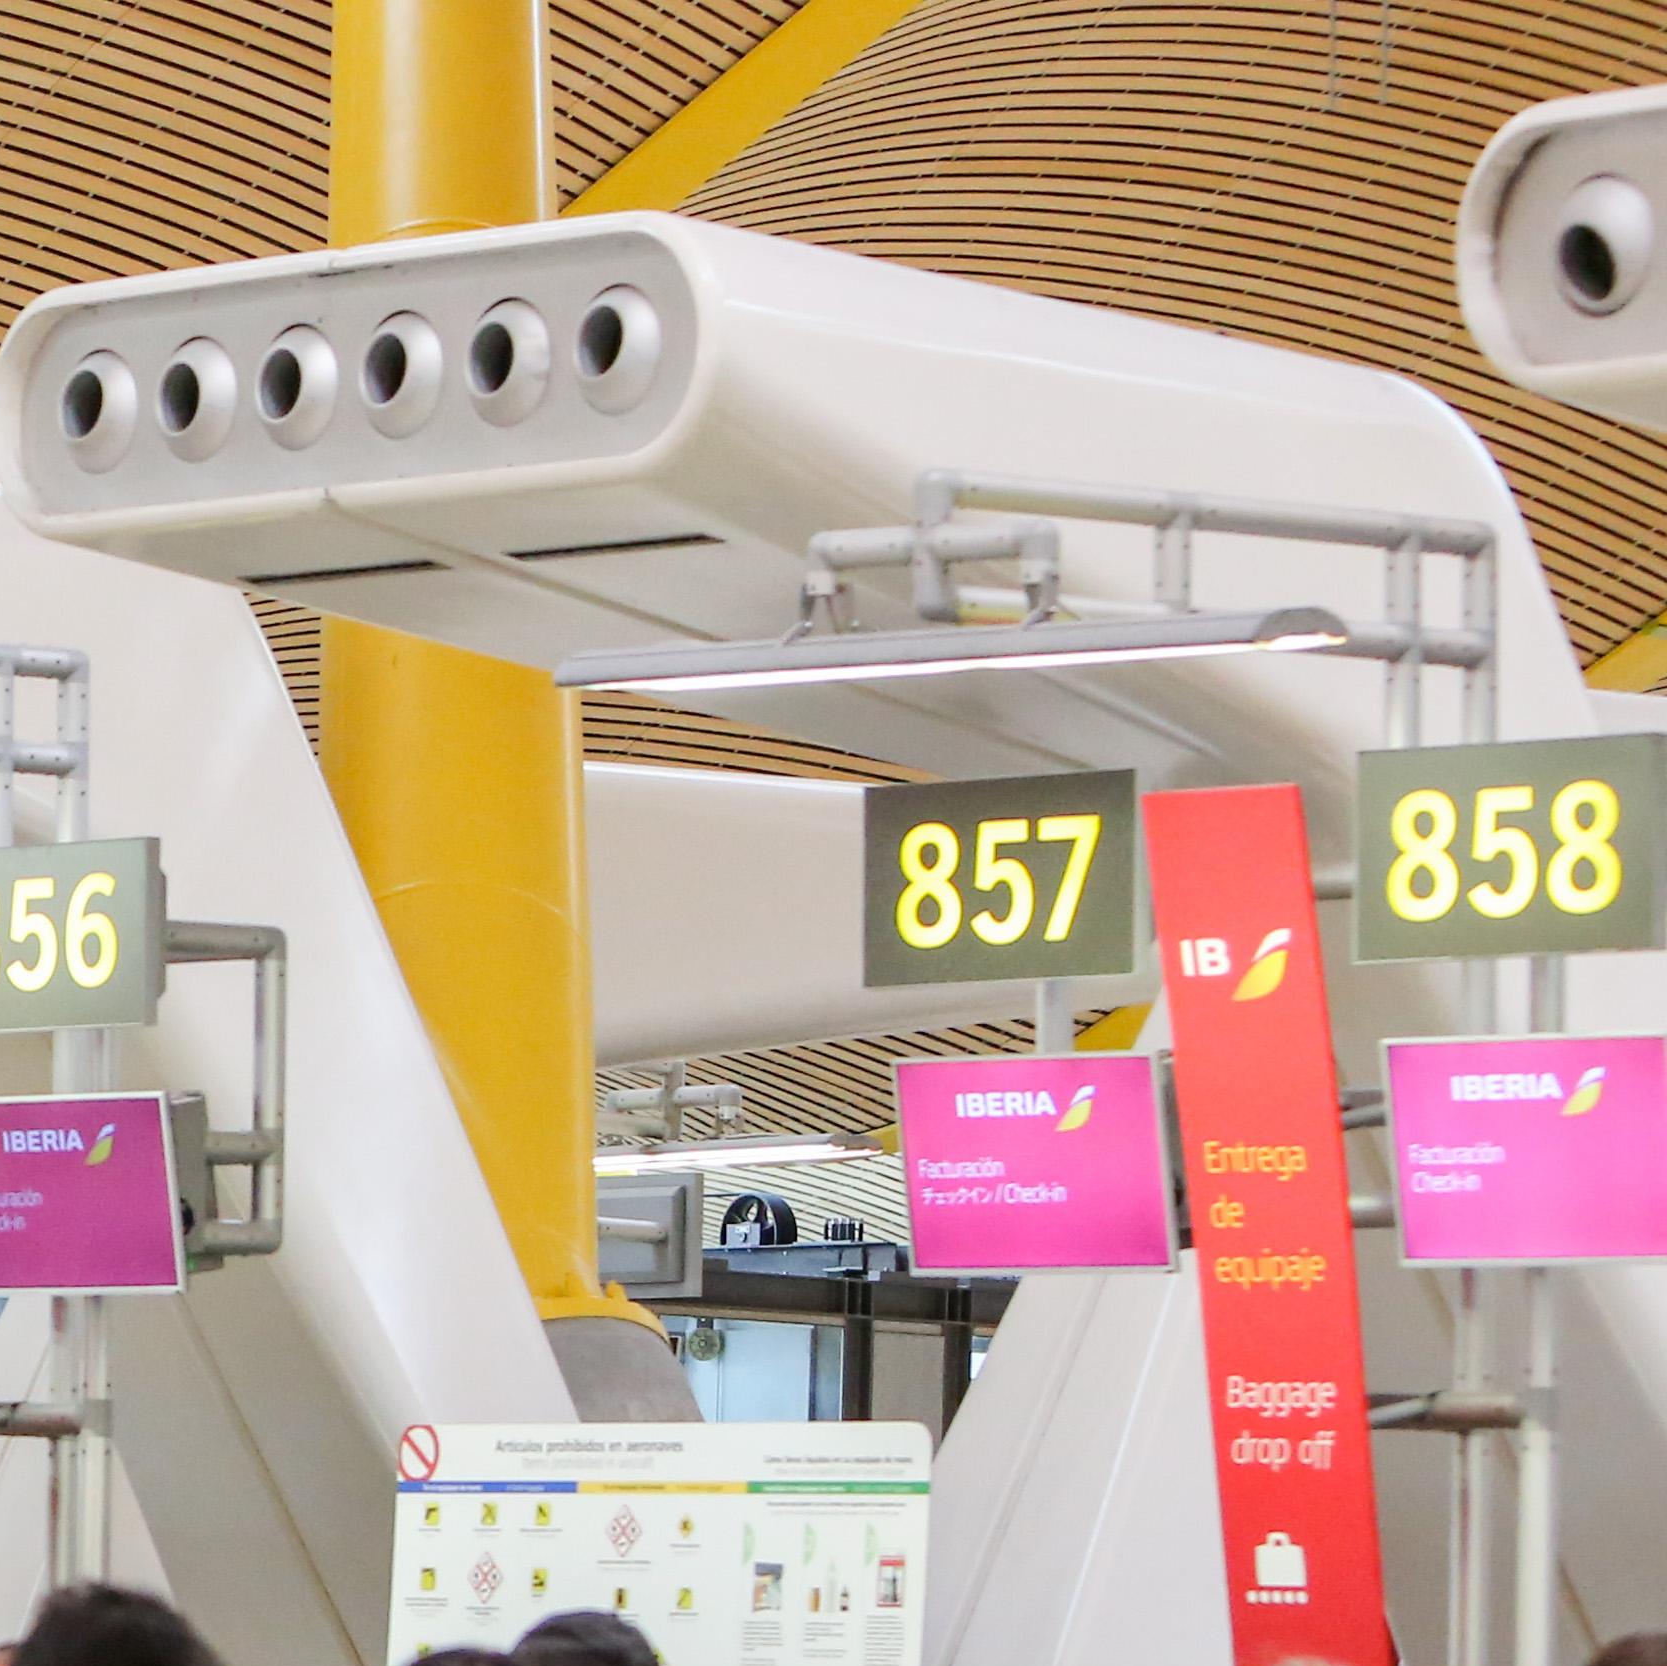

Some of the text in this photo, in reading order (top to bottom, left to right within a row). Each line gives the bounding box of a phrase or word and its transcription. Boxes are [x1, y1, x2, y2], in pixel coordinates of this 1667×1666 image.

[1386, 779, 1623, 921] 858
[896, 813, 1101, 949] 857
[1181, 939, 1230, 976] IB
[955, 1092, 1056, 1117] IBERIA
[1450, 1073, 1562, 1100] IBERIA
[2, 1129, 84, 1152] IBERIA
[1408, 1143, 1505, 1165] Facturación
[917, 1156, 1005, 1179] Facturación
[1203, 1141, 1307, 1181] Entrega
[1210, 1196, 1244, 1228] de
[1215, 1250, 1327, 1290] equipaje
[1226, 1375, 1337, 1417] Baggage
[1231, 1431, 1336, 1473] drop off
